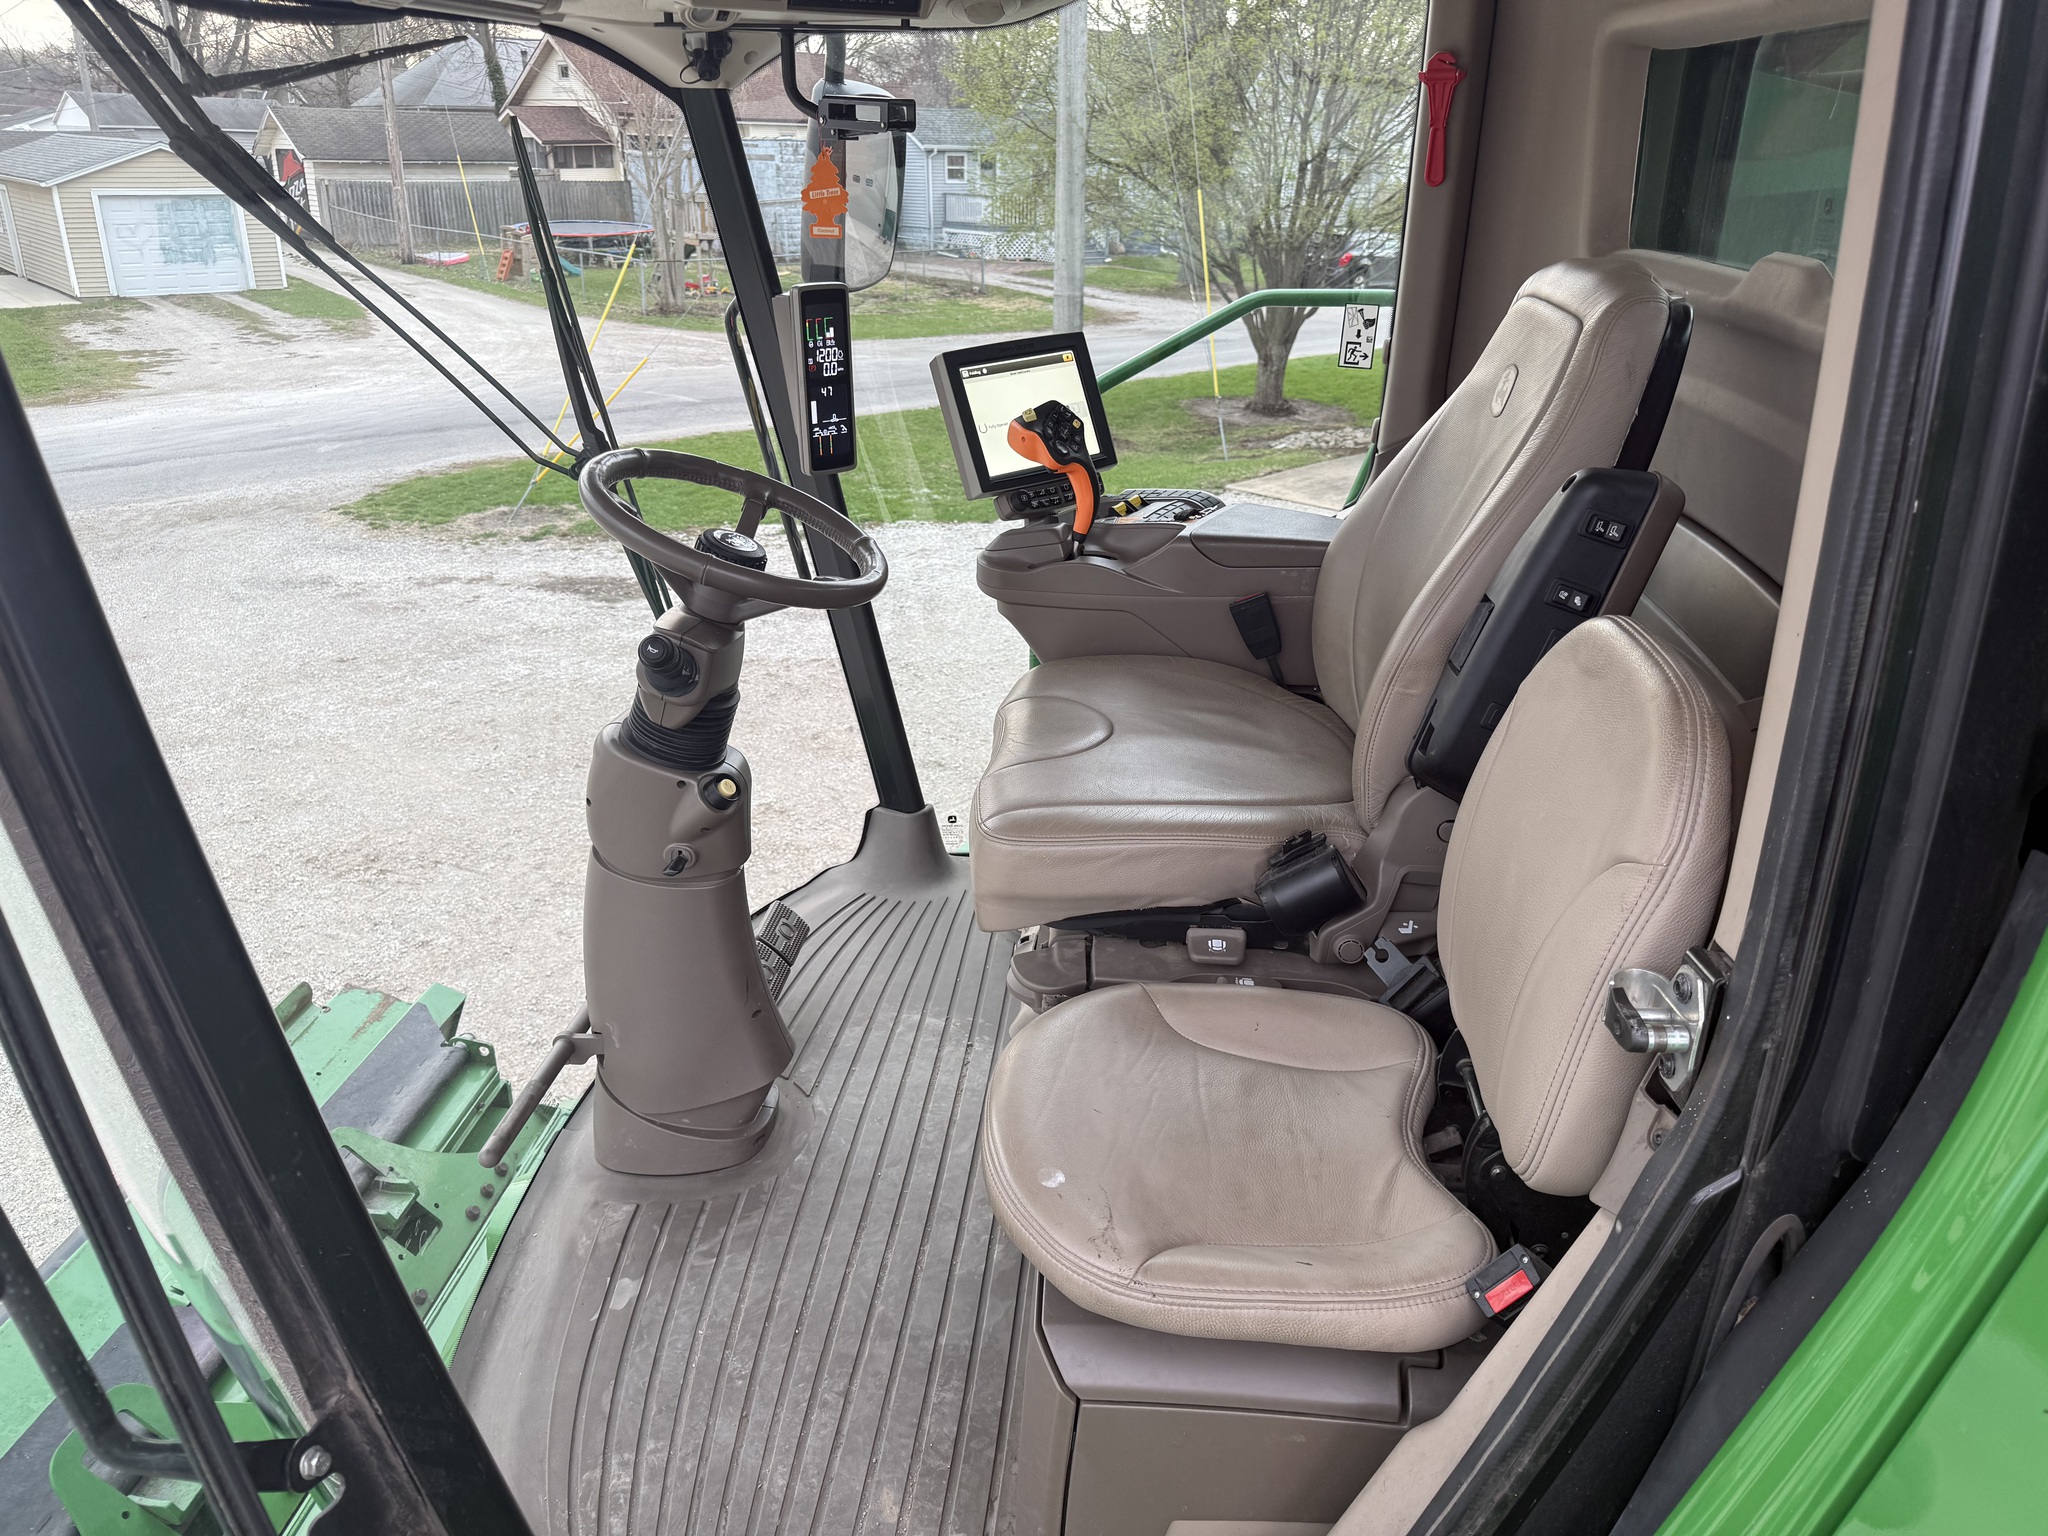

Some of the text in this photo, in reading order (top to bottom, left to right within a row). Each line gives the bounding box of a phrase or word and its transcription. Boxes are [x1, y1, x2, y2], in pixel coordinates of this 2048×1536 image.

[811, 190, 825, 198] Little
[816, 347, 838, 363] 1200
[823, 362, 838, 377] 0.0
[820, 385, 833, 397] 47
